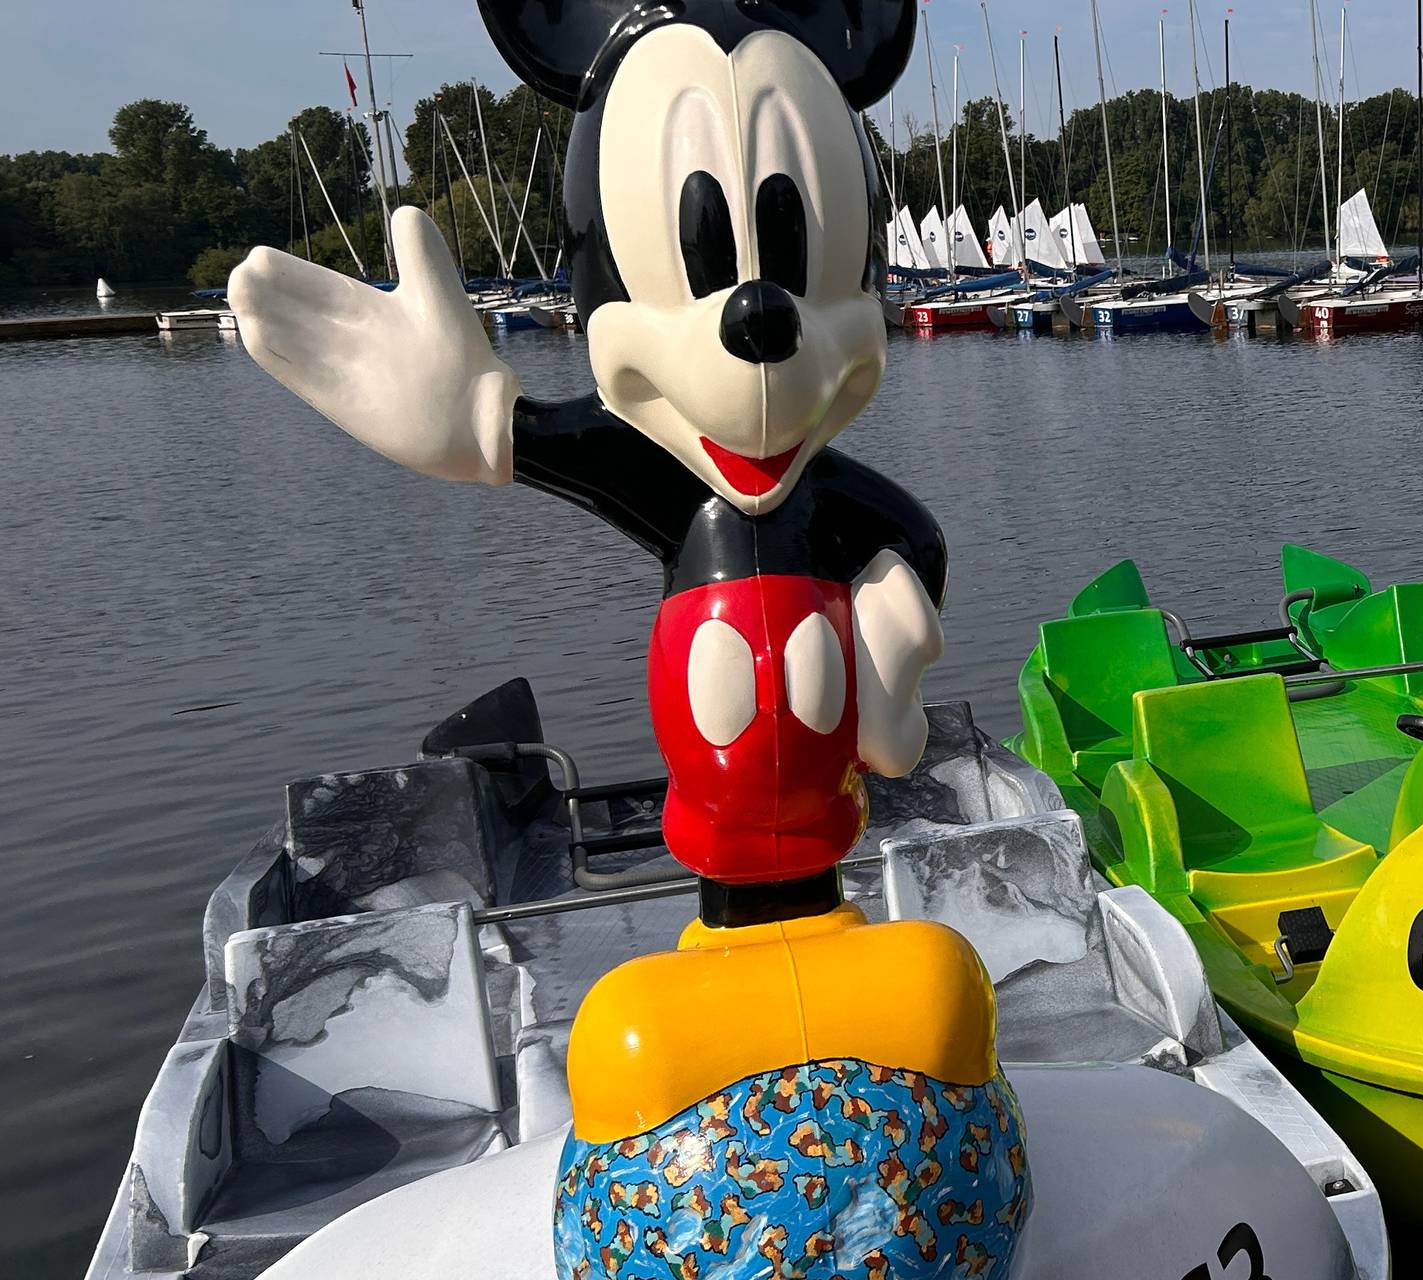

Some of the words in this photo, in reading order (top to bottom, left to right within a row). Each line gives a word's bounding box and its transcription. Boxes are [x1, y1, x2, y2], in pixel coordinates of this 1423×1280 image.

[916, 311, 929, 323] 23
[1016, 310, 1029, 322] 27
[1098, 310, 1111, 323] 32
[1314, 307, 1329, 319] 40
